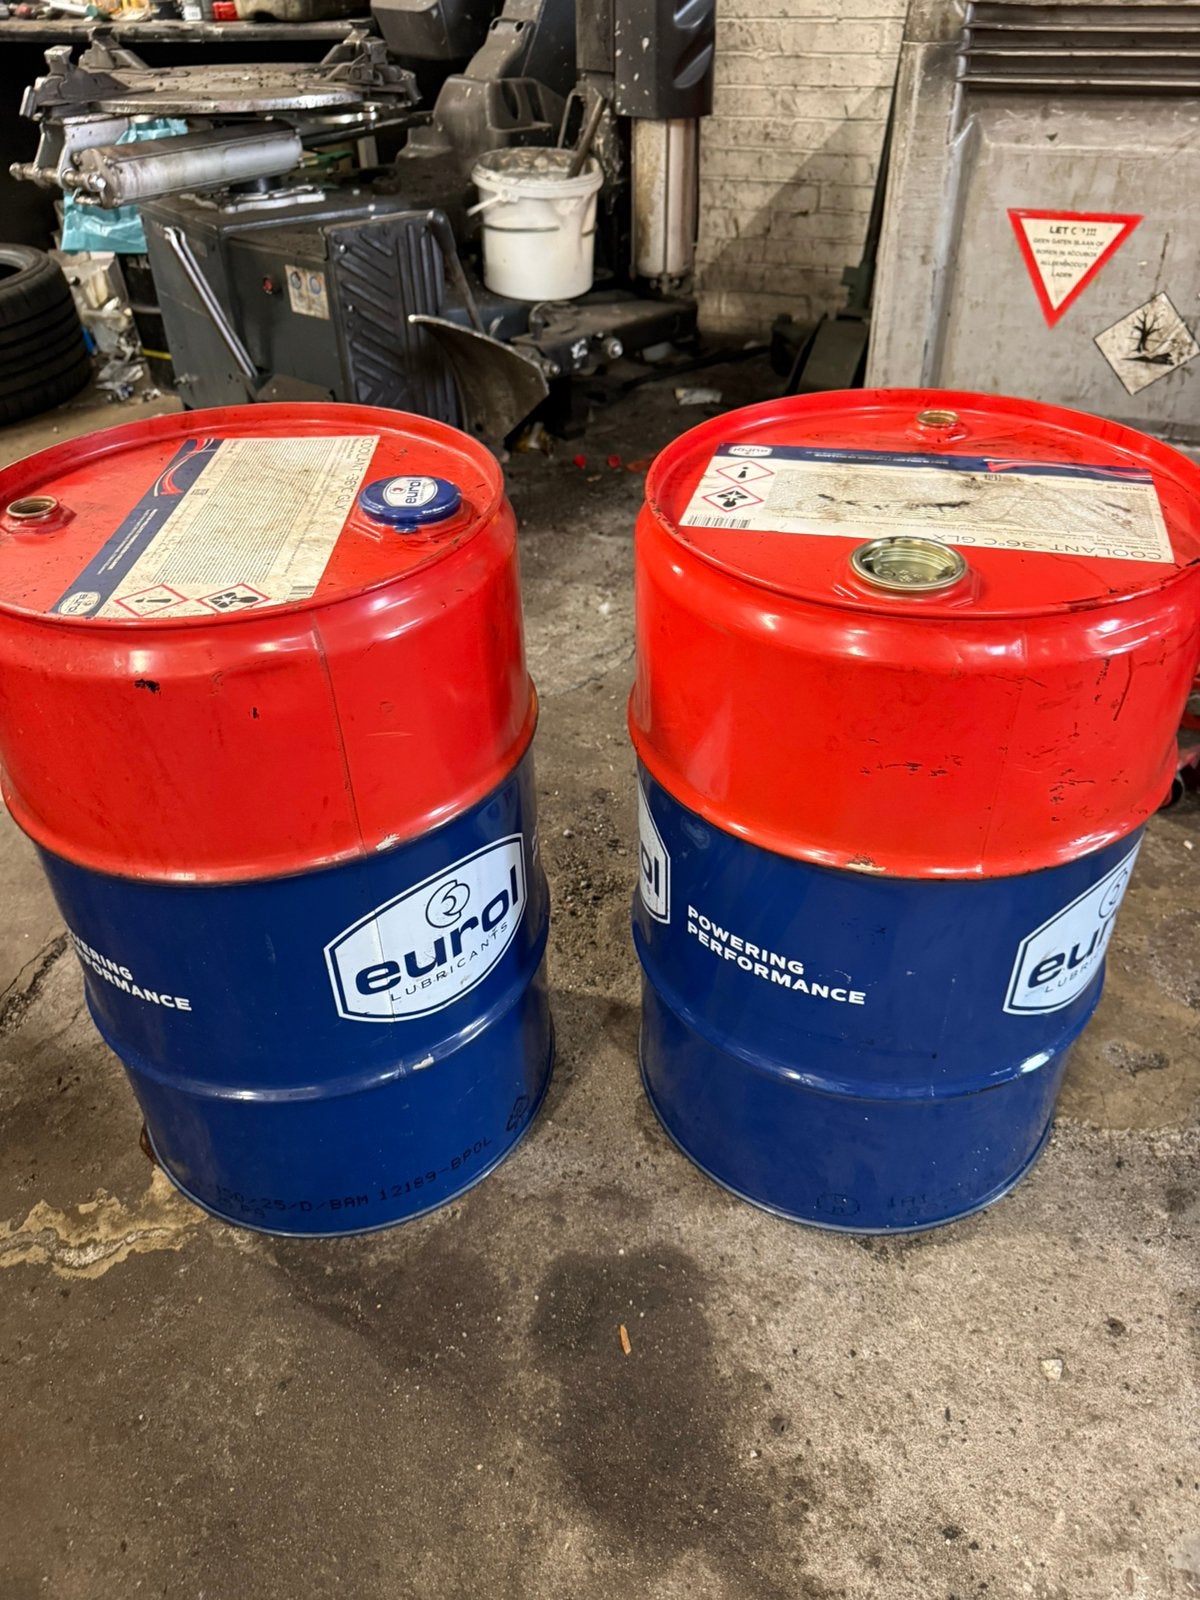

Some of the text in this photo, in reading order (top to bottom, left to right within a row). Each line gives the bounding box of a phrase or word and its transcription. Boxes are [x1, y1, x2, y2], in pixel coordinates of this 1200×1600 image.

[1049, 226, 1069, 235] LET
[350, 438, 374, 472] COOLANT
[405, 479, 422, 504] eurol
[933, 533, 976, 544] GLX
[984, 537, 1044, 550] -36°C
[1052, 542, 1162, 561] COOLANT
[355, 864, 519, 996] eurol
[687, 904, 805, 976] POWERING
[390, 921, 508, 1002] LUBRICANTS
[687, 921, 867, 1005] PERFORMANCE
